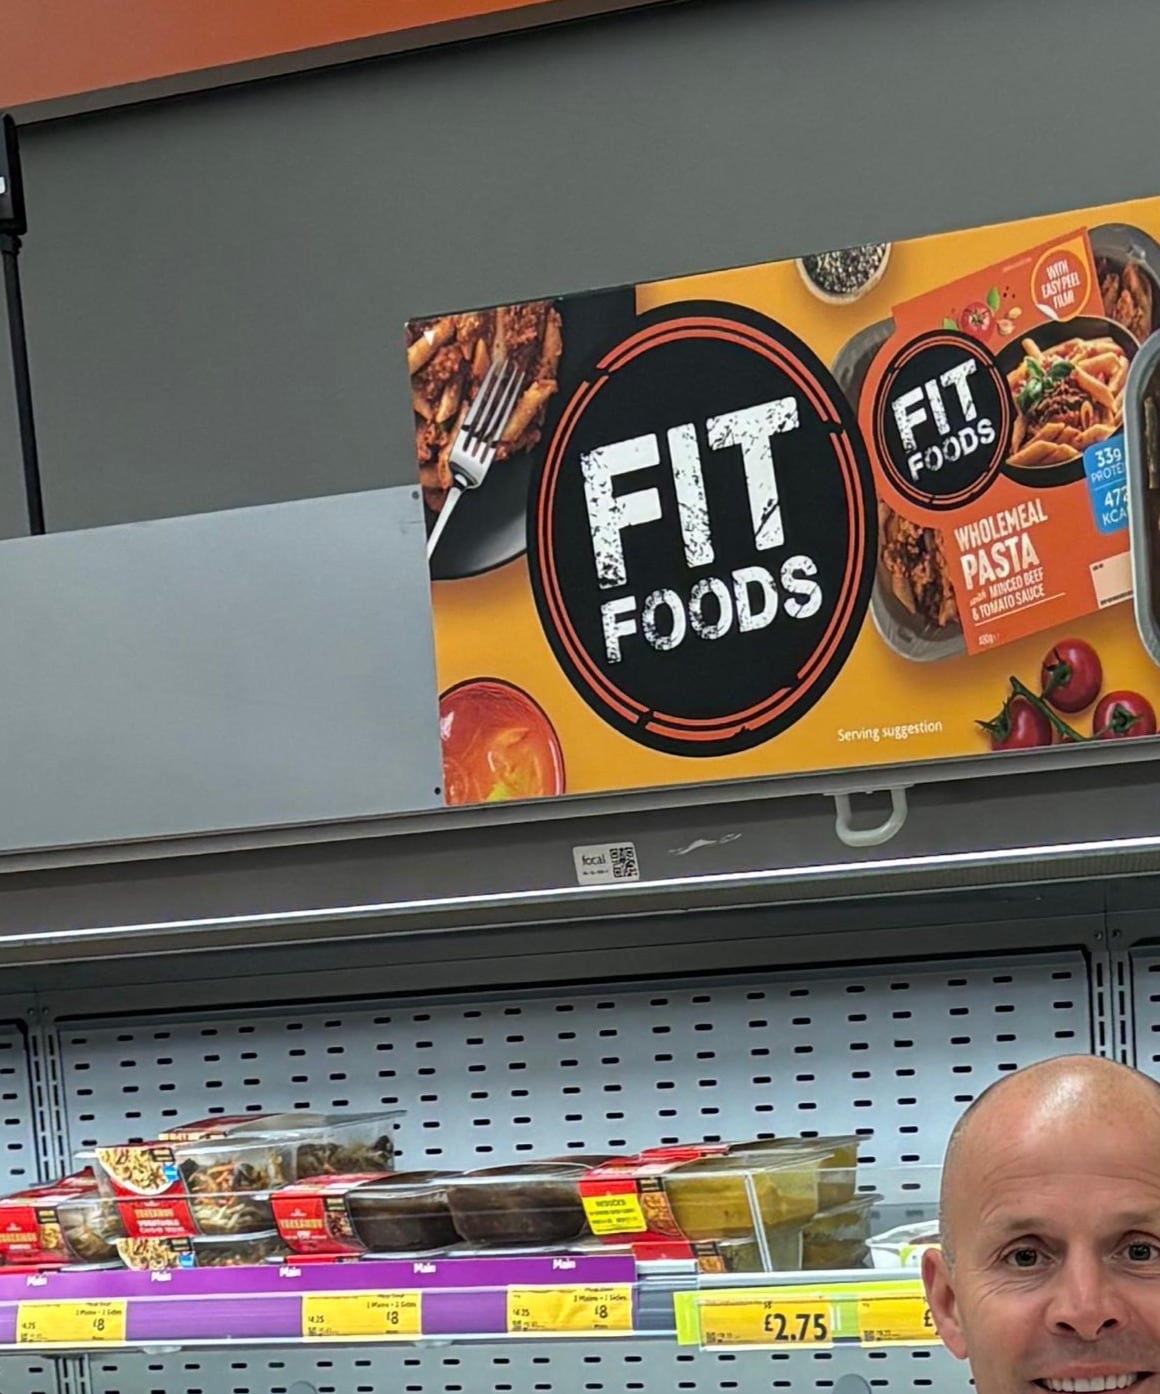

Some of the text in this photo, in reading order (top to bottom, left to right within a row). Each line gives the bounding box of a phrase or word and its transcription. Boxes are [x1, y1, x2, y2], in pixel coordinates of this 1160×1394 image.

[892, 358, 977, 452] FIT
[907, 418, 996, 481] FOODS
[1095, 447, 1122, 468] 33g
[579, 396, 799, 590] FIT
[954, 498, 1048, 552] WHOLEMEAL
[960, 532, 1040, 591] PASTA
[980, 594, 1015, 618] TOMATO
[1015, 584, 1045, 606] SAUCE
[988, 577, 1023, 600] MINCED
[602, 554, 824, 664] FOODS
[838, 719, 942, 743] Serving suggestion
[413, 1262, 436, 1274] Main
[552, 1258, 576, 1270] Main
[764, 1312, 828, 1342] £2.75
